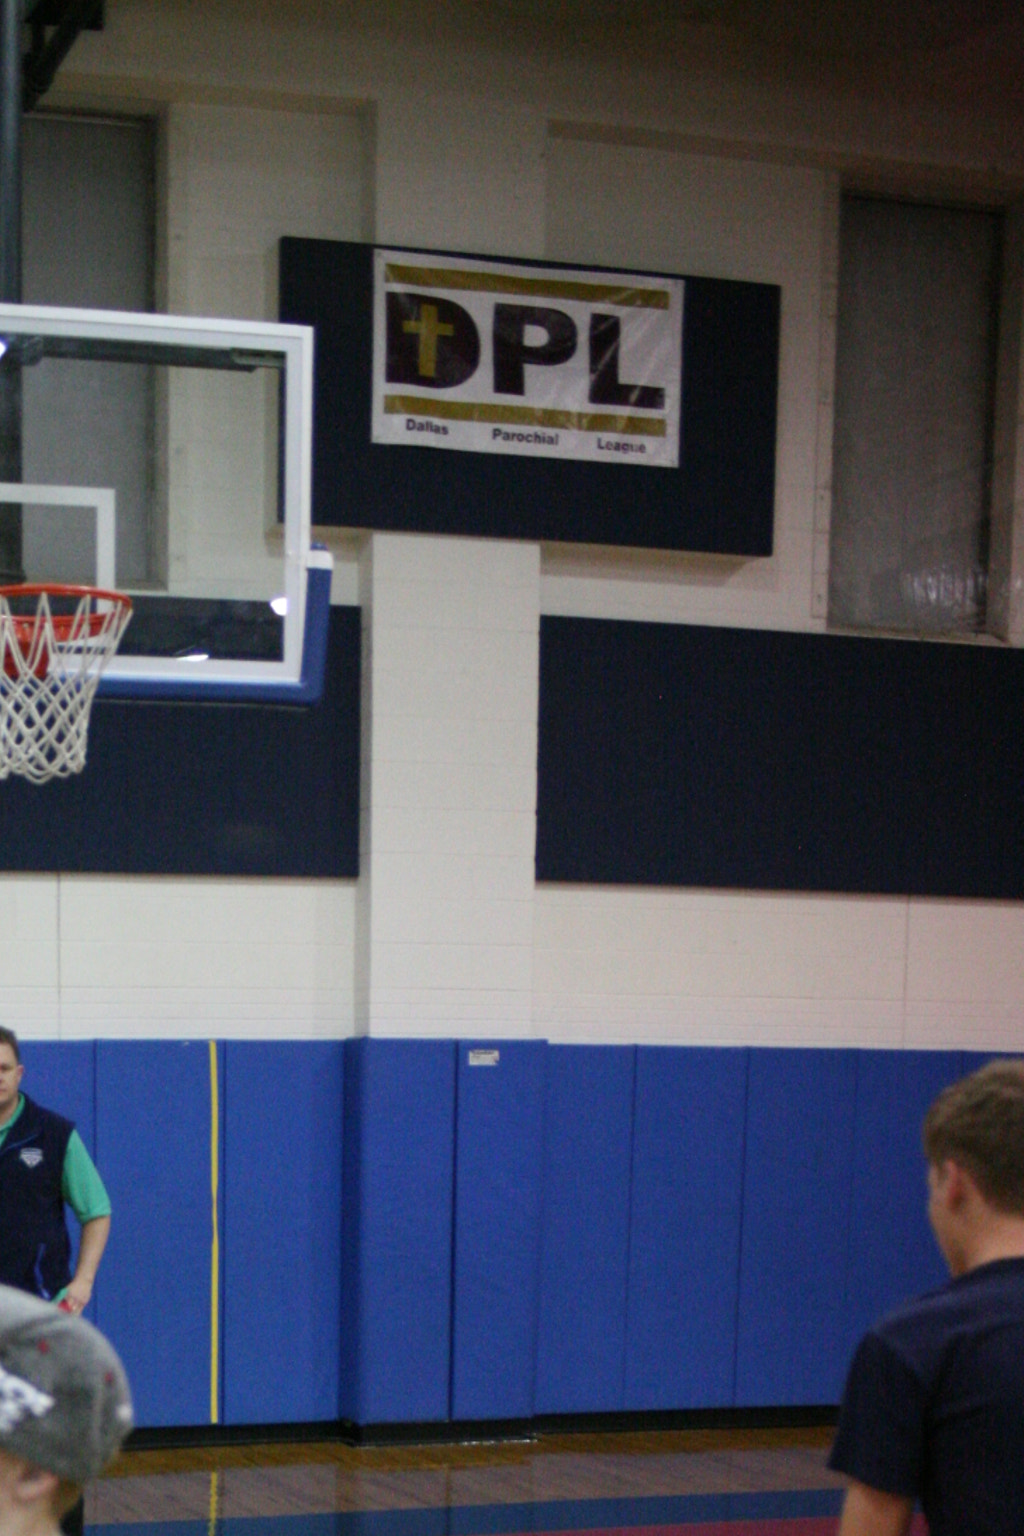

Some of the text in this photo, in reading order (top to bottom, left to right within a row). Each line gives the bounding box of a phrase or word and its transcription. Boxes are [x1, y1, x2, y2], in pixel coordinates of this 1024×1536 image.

[385, 290, 667, 410] DPL
[405, 418, 647, 455] Dallas Parochial League
